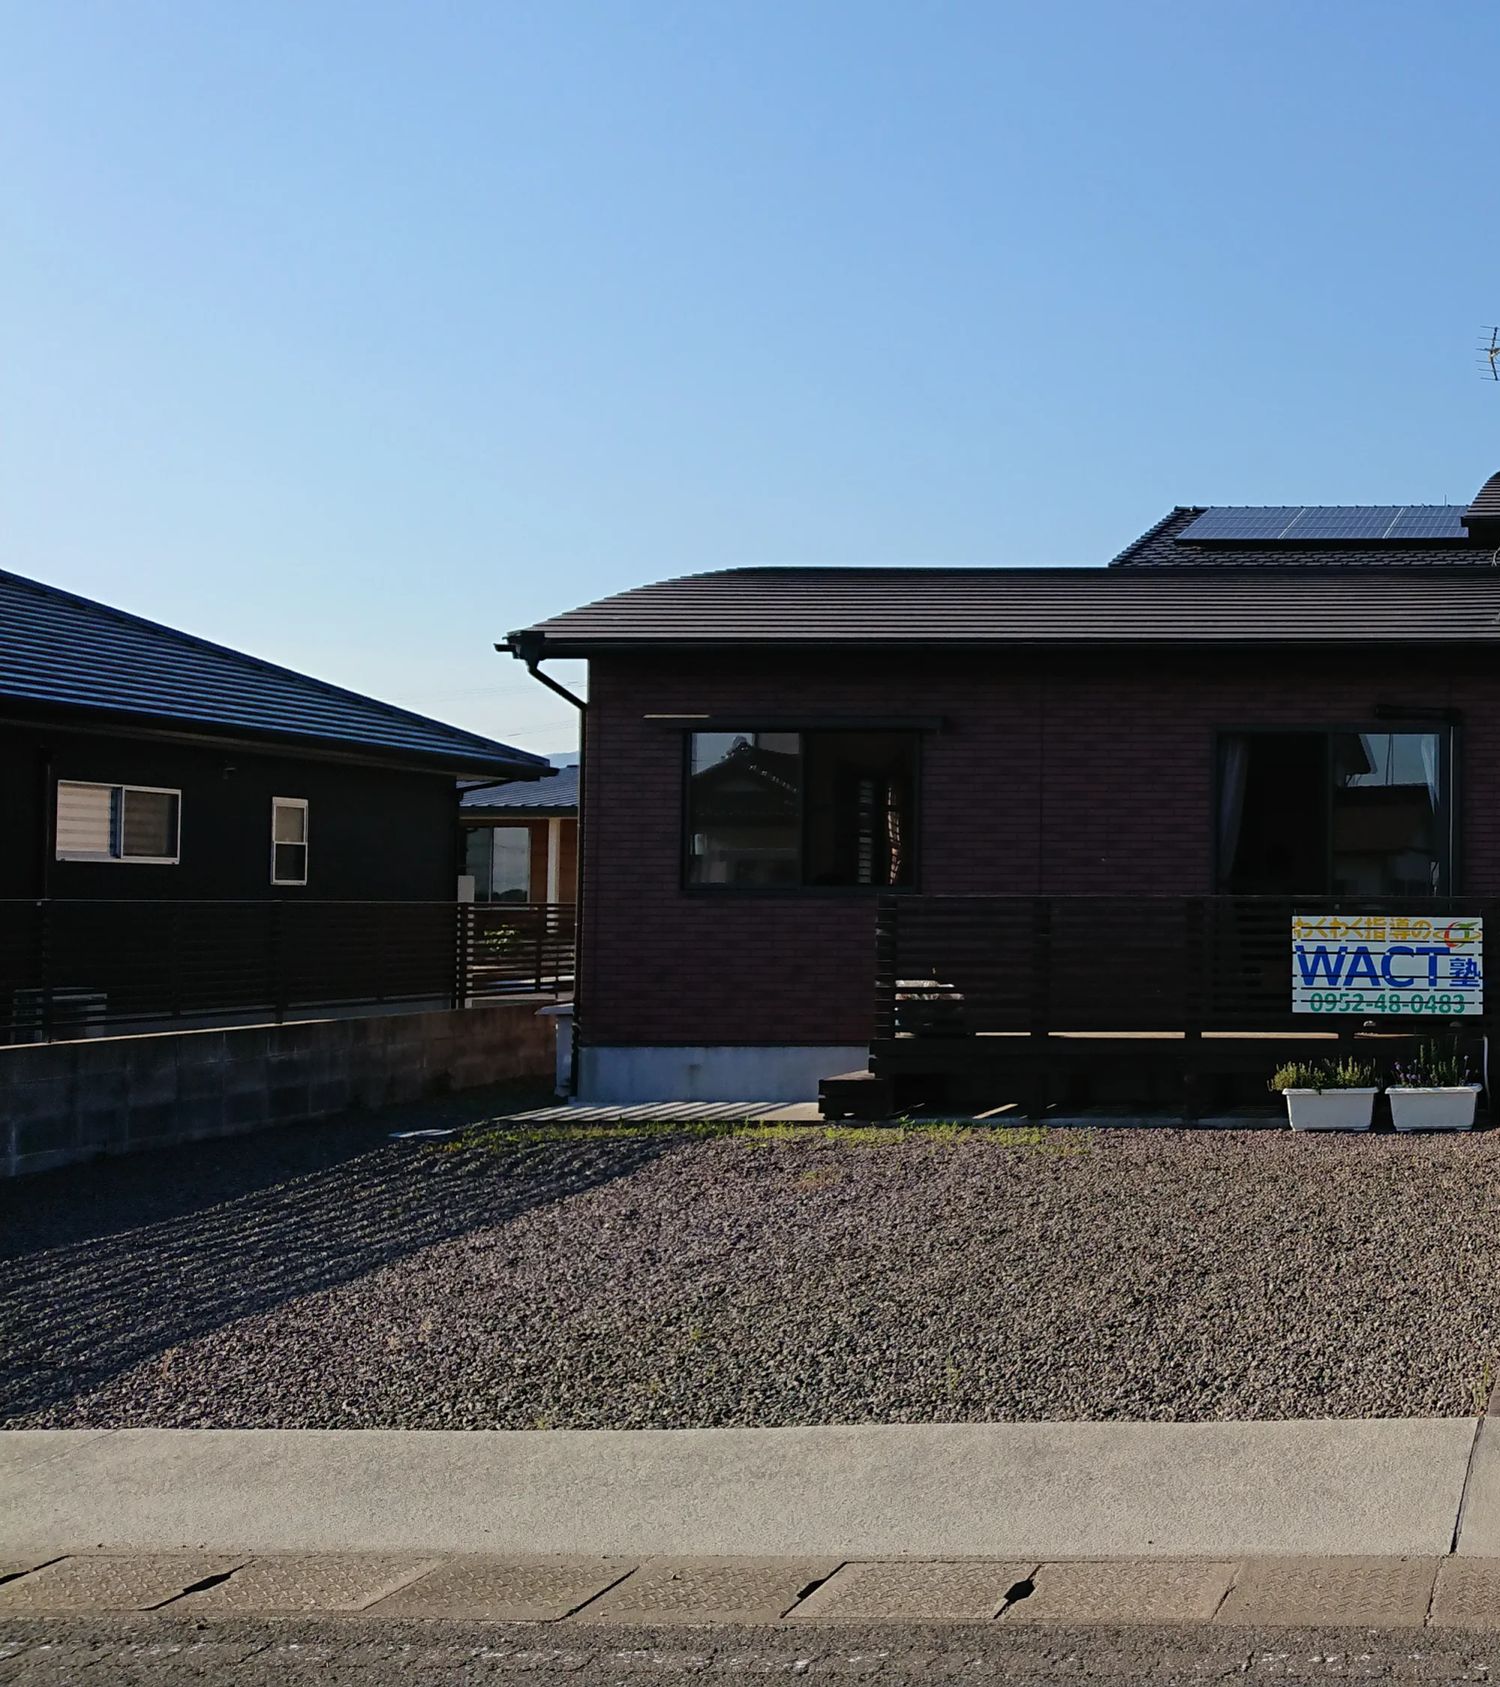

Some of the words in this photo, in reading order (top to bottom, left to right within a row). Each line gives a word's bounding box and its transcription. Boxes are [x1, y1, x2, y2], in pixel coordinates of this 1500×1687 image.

[1294, 917, 1432, 940] わくわく指導の
[1310, 992, 1465, 1014] 0952-48-0483
